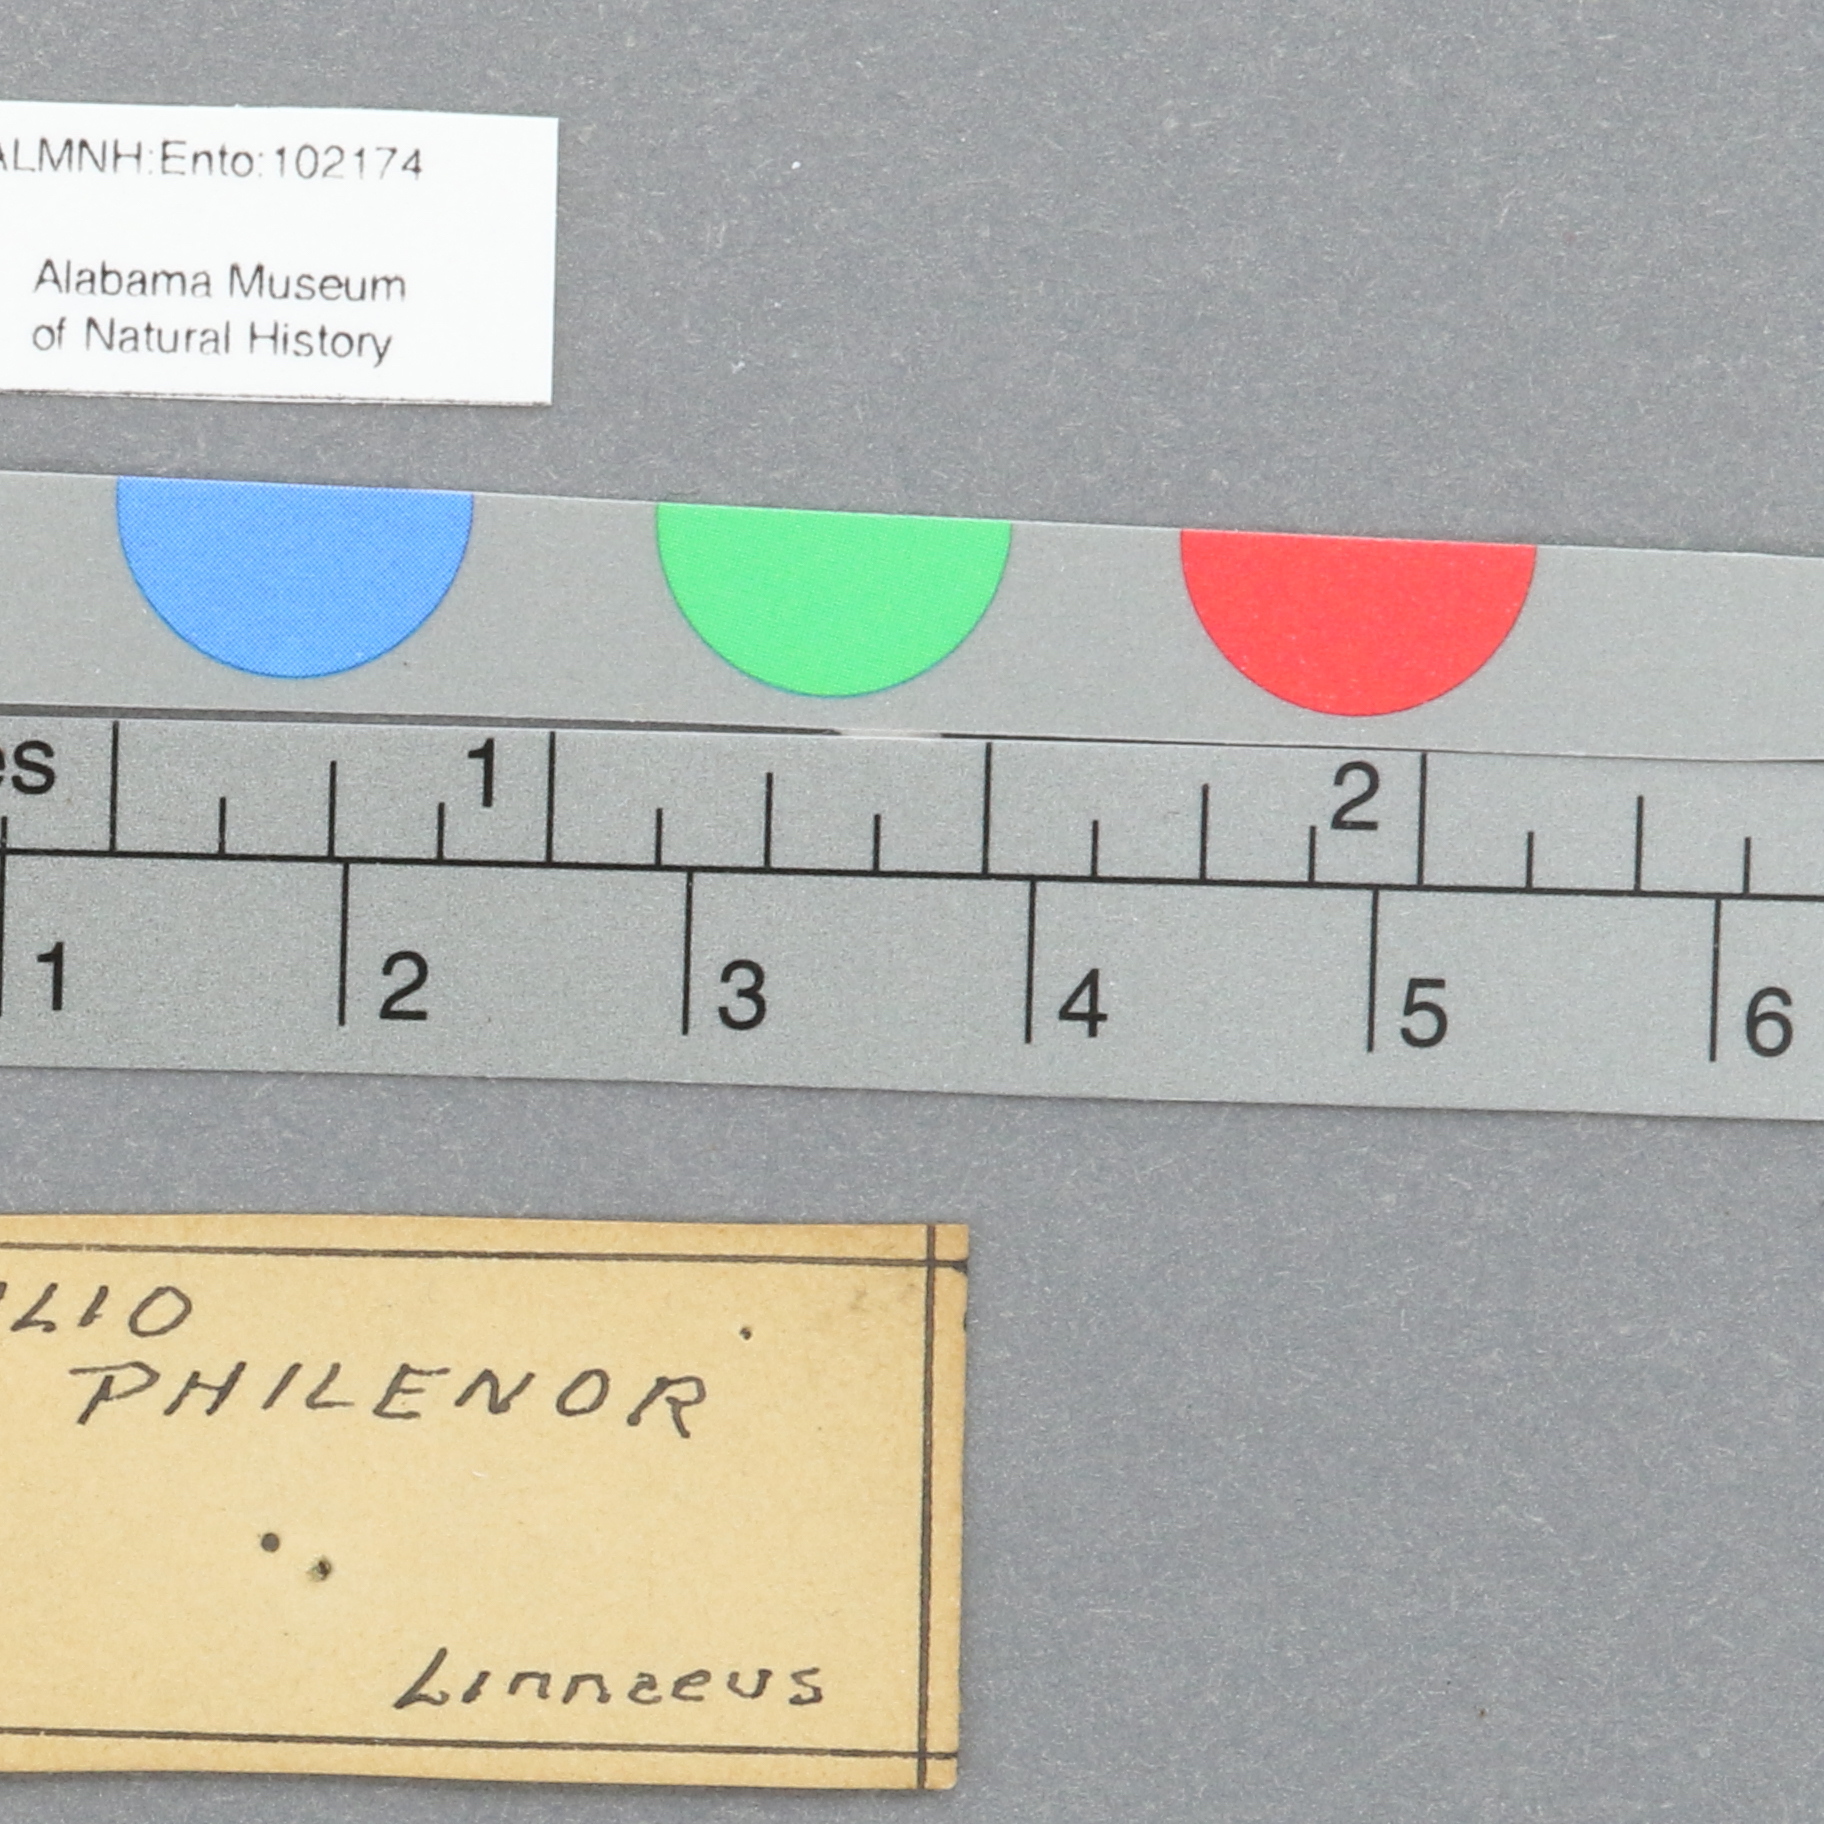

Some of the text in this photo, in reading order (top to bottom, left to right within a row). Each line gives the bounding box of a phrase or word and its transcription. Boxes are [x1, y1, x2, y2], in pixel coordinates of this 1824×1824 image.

[34, 257, 407, 303] Alabama Museum
[31, 315, 393, 369] of Natural History
[466, 736, 496, 809] 1
[1329, 759, 1382, 832] 2
[35, 940, 1795, 1059] 1 2 3 4 5 6
[67, 1359, 708, 1441] PHILENOR
[391, 1645, 825, 1711] Linnaeus
